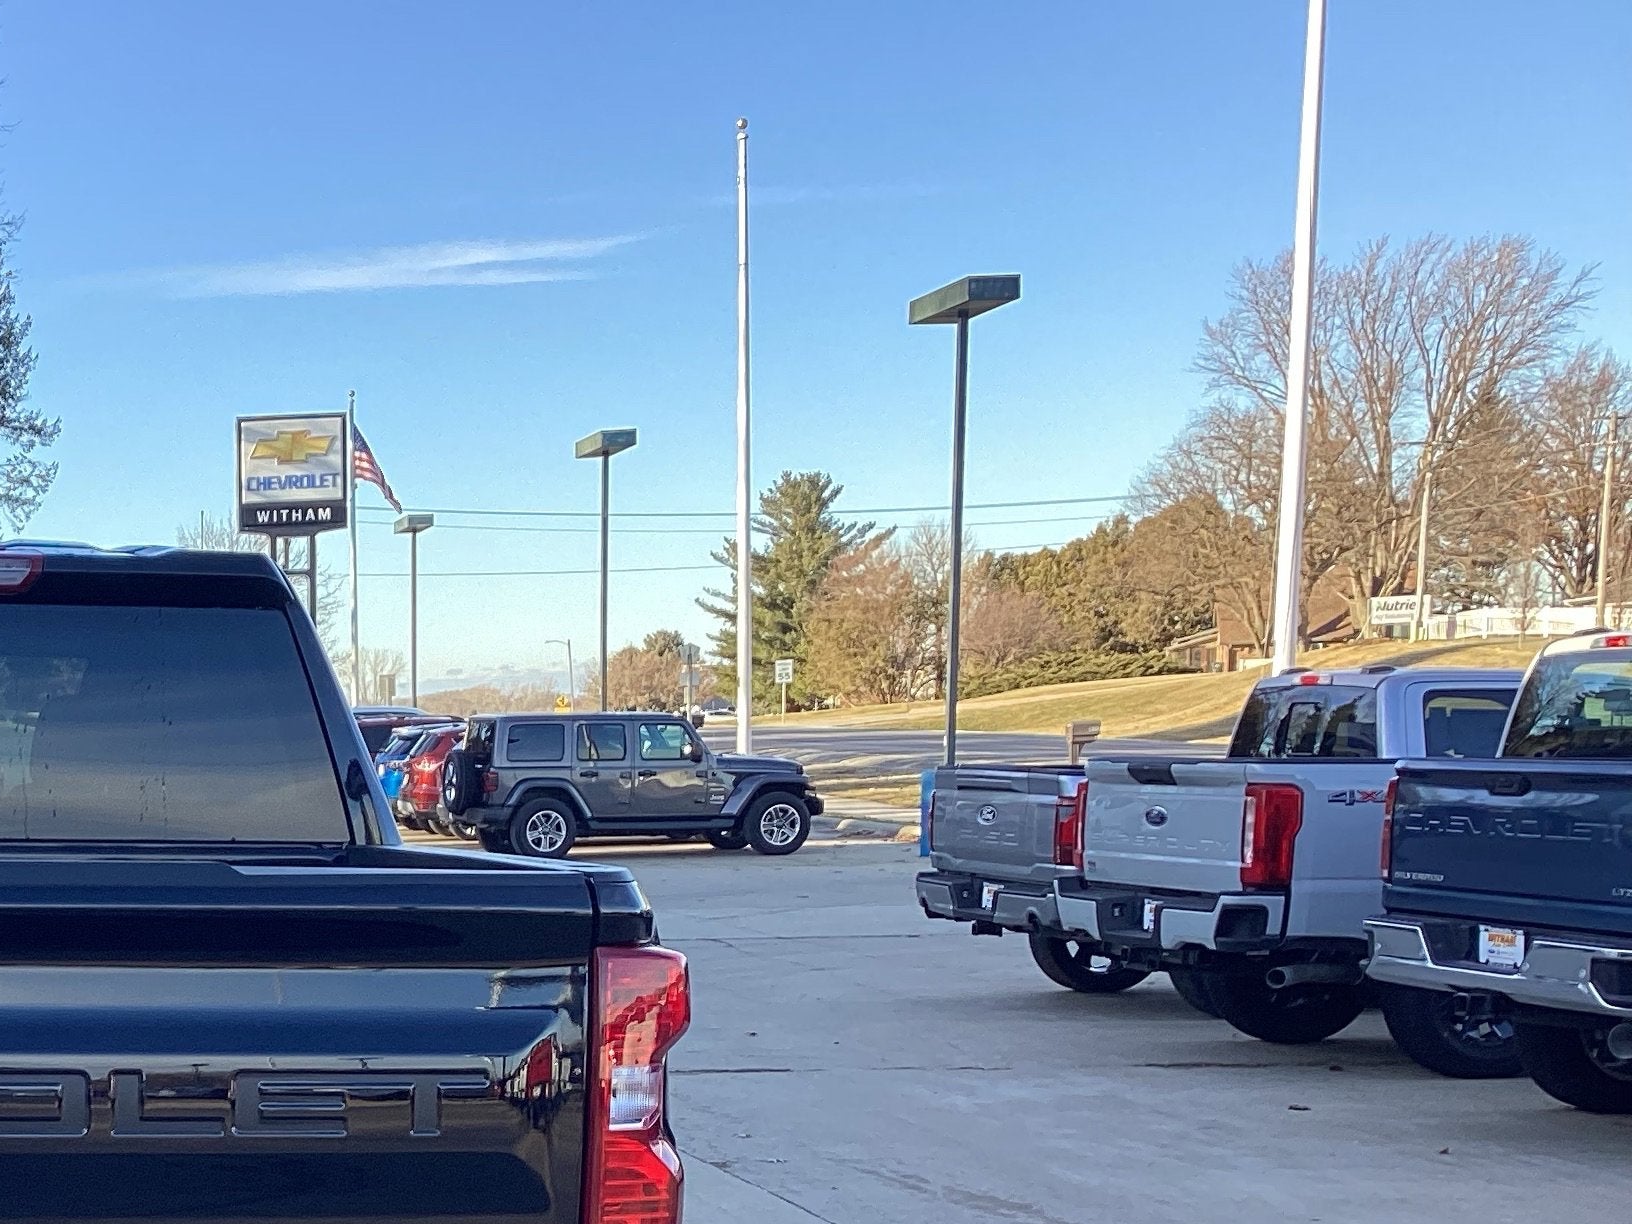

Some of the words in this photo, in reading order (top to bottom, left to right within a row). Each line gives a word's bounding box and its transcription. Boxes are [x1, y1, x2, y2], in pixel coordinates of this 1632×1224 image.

[246, 472, 340, 492] CHEVROLET
[256, 507, 332, 524] WITHAM
[1376, 599, 1417, 612] Nutrie
